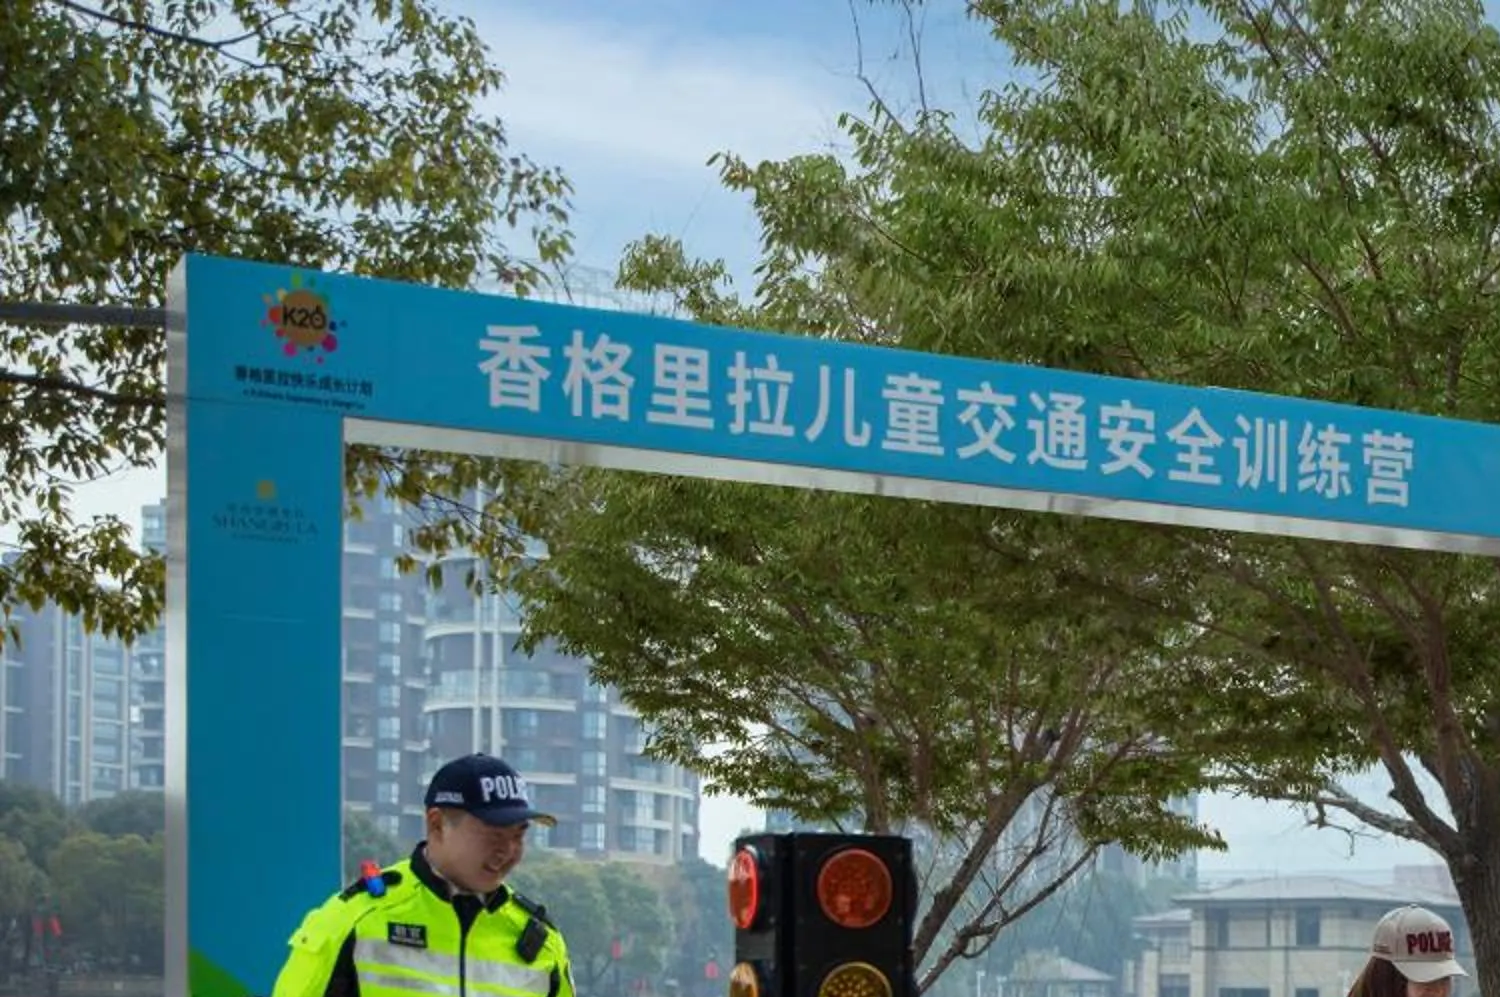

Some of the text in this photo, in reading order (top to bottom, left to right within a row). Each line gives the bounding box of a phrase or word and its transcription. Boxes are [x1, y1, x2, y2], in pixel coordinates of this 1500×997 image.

[478, 324, 1414, 508] 香格里拉儿童交通安全训练营
[479, 775, 529, 803] POLI
